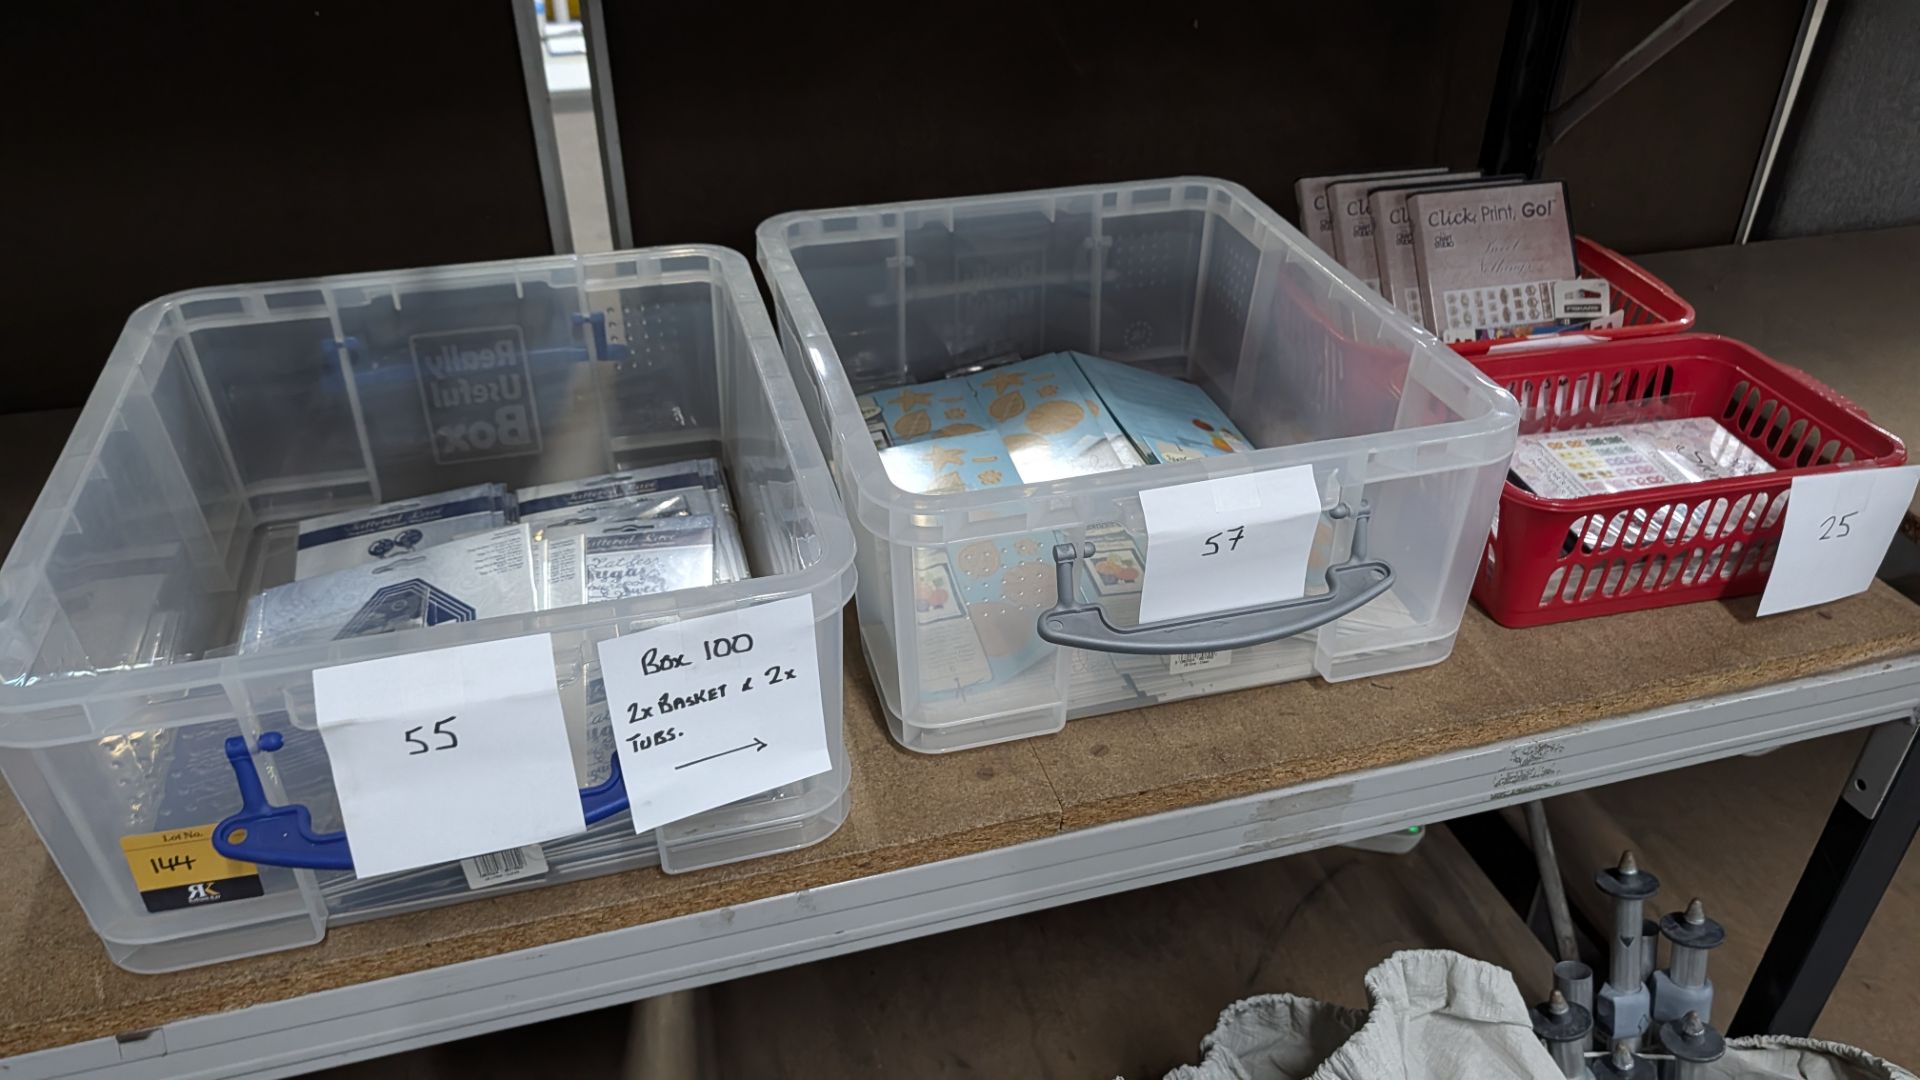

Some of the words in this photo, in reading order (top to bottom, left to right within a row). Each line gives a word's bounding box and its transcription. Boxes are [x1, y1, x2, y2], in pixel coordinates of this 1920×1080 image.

[1481, 203, 1517, 222] Print,
[1521, 199, 1552, 218] Go!
[1201, 525, 1245, 556] 57
[1819, 511, 1859, 540] 25
[641, 648, 693, 675] Box
[704, 633, 754, 660] 100
[626, 702, 654, 724] 2x
[657, 684, 727, 714] BASKET
[764, 665, 797, 685] 2x
[405, 716, 457, 755] 55
[162, 832, 181, 842] Lot
[184, 829, 204, 839] No.
[150, 855, 196, 874] 144
